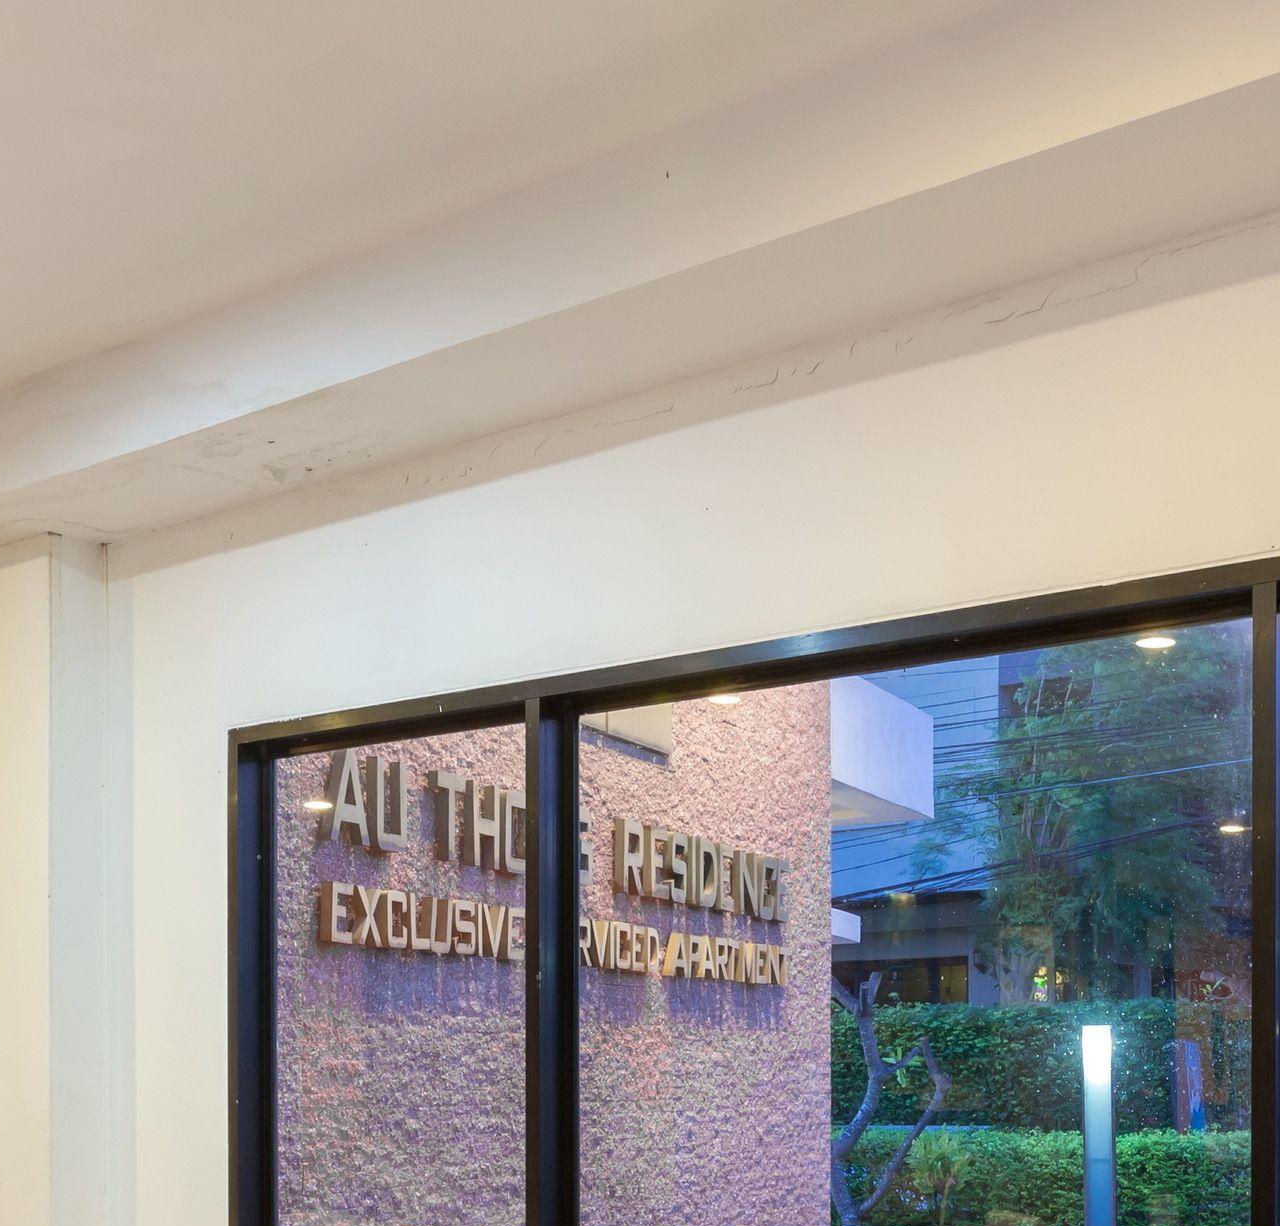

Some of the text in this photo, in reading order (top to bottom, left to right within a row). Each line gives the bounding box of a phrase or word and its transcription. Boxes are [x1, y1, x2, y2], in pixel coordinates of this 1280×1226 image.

[322, 748, 409, 852] AU
[616, 819, 790, 922] RESIDENCE
[323, 881, 790, 985] EXCLUSIVE RVICED APARTMENT
